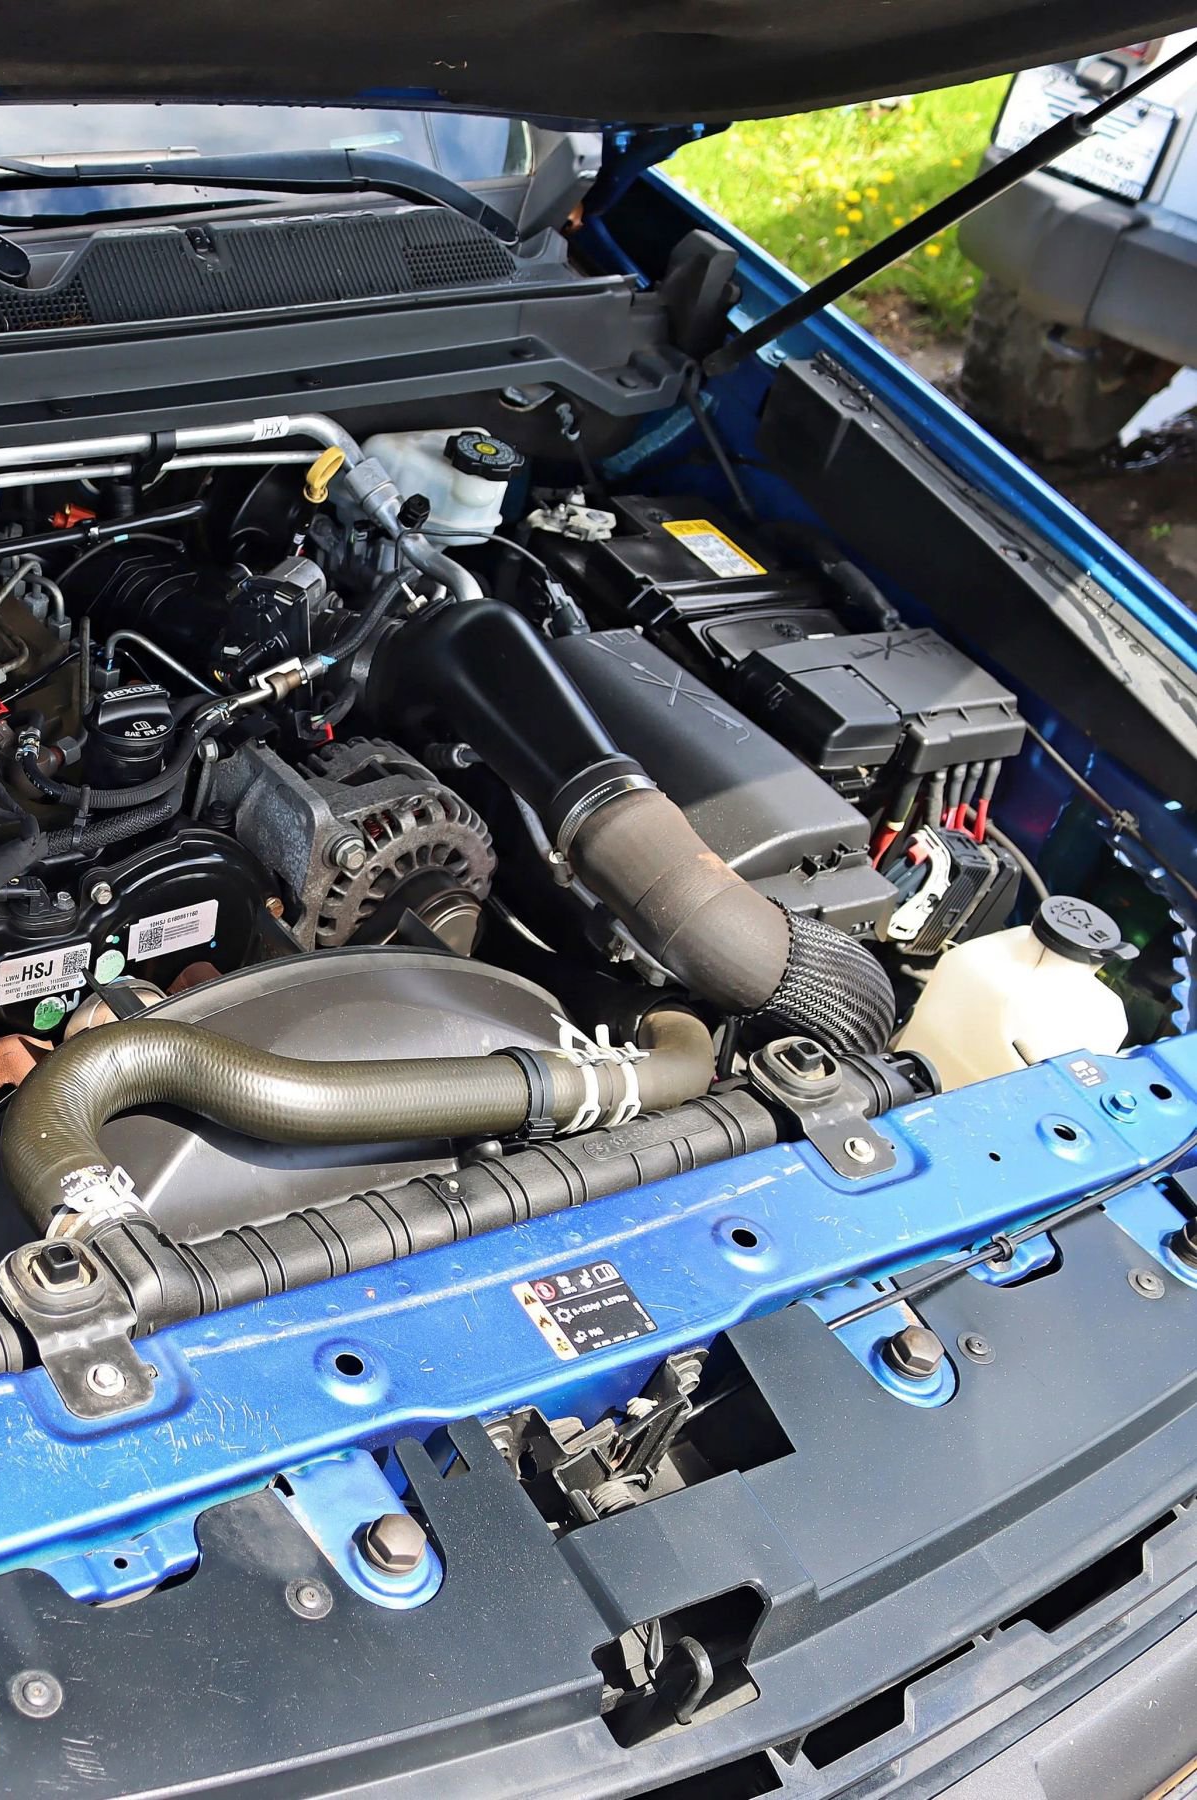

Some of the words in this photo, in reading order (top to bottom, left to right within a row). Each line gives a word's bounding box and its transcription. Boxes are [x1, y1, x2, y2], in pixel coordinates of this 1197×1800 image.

[103, 684, 162, 700] dexos2
[124, 730, 142, 738] SAE
[21, 960, 54, 982] HSJ
[5, 973, 20, 983] LWN
